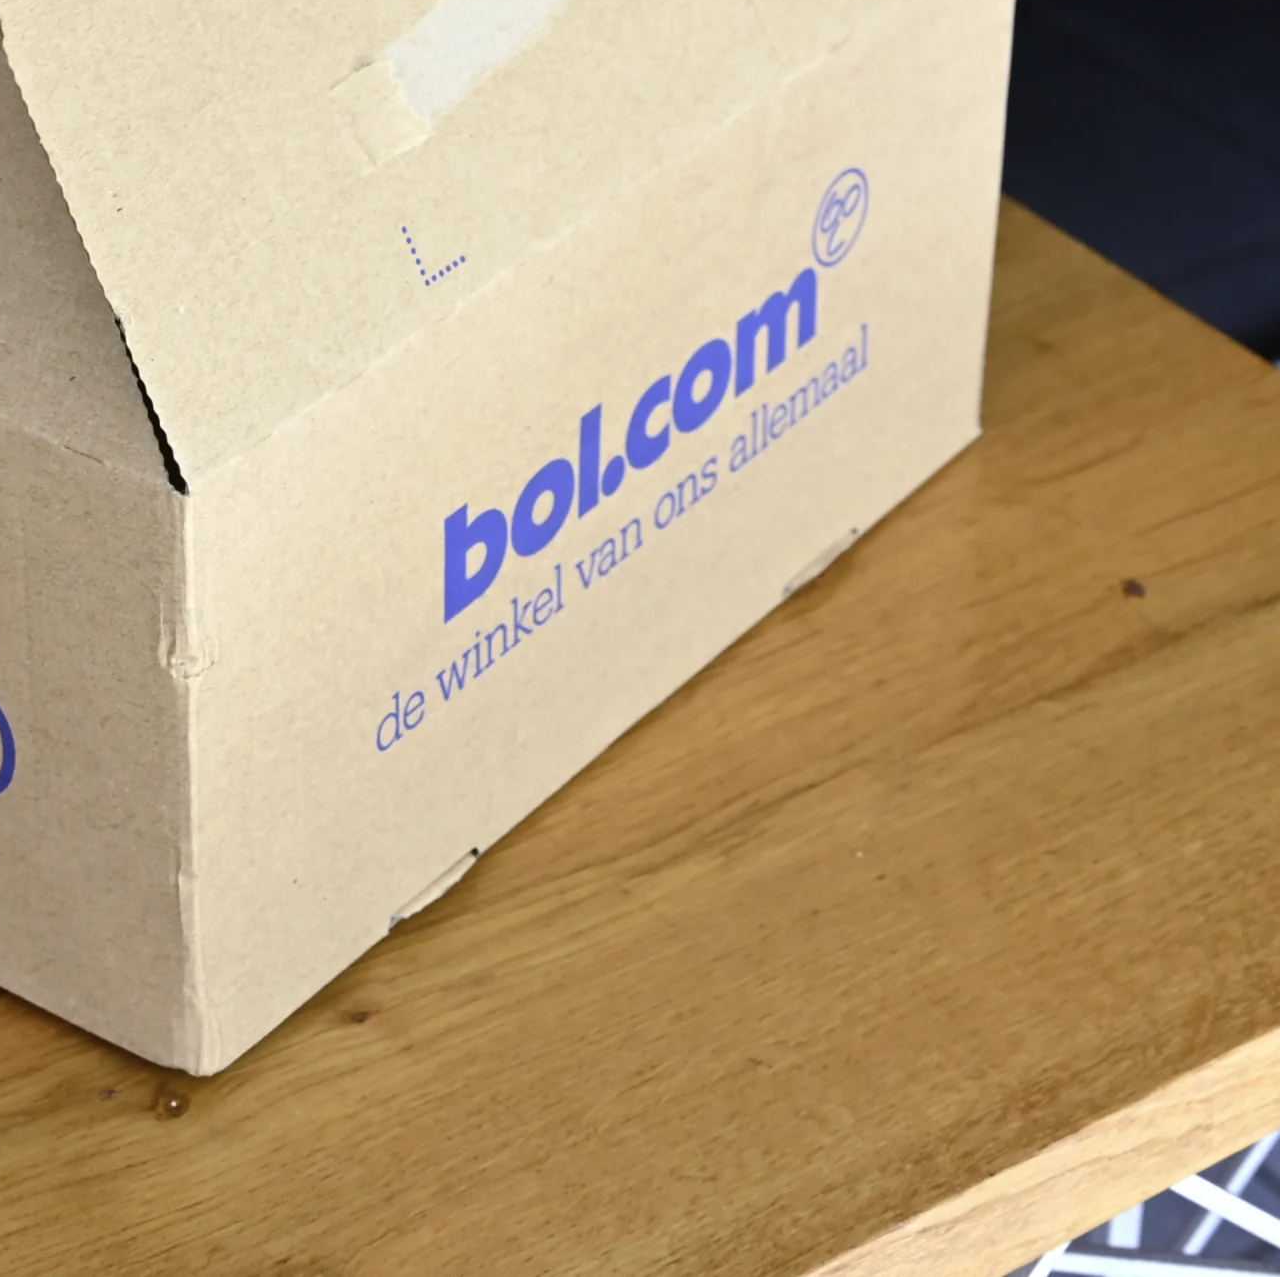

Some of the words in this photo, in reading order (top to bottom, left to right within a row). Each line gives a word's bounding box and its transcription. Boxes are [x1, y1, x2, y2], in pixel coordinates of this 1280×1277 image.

[376, 690, 426, 752] de
[435, 562, 565, 702] winkel
[575, 517, 644, 590] van
[654, 456, 719, 530] ons
[729, 323, 869, 474] allemaal
[443, 266, 819, 624] bol.com
